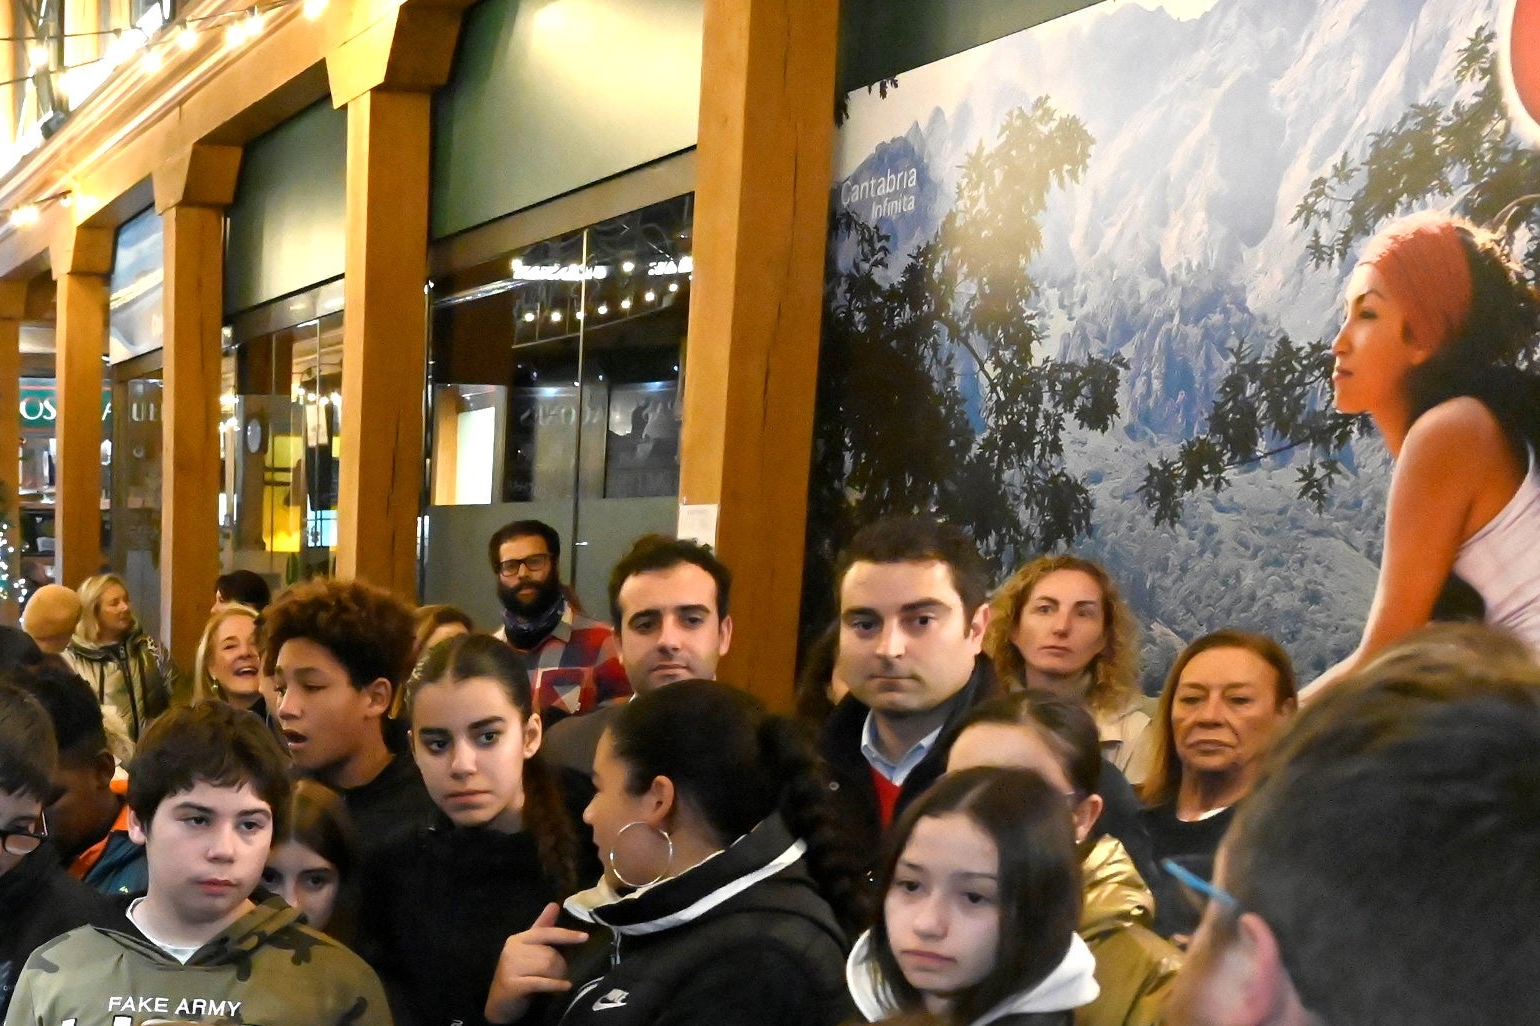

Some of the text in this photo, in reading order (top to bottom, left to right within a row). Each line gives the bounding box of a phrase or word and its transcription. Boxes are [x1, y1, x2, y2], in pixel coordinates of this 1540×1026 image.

[841, 165, 917, 209] Cantabria
[871, 193, 915, 221] Infinita
[108, 997, 241, 1017] FAKE ARMY
